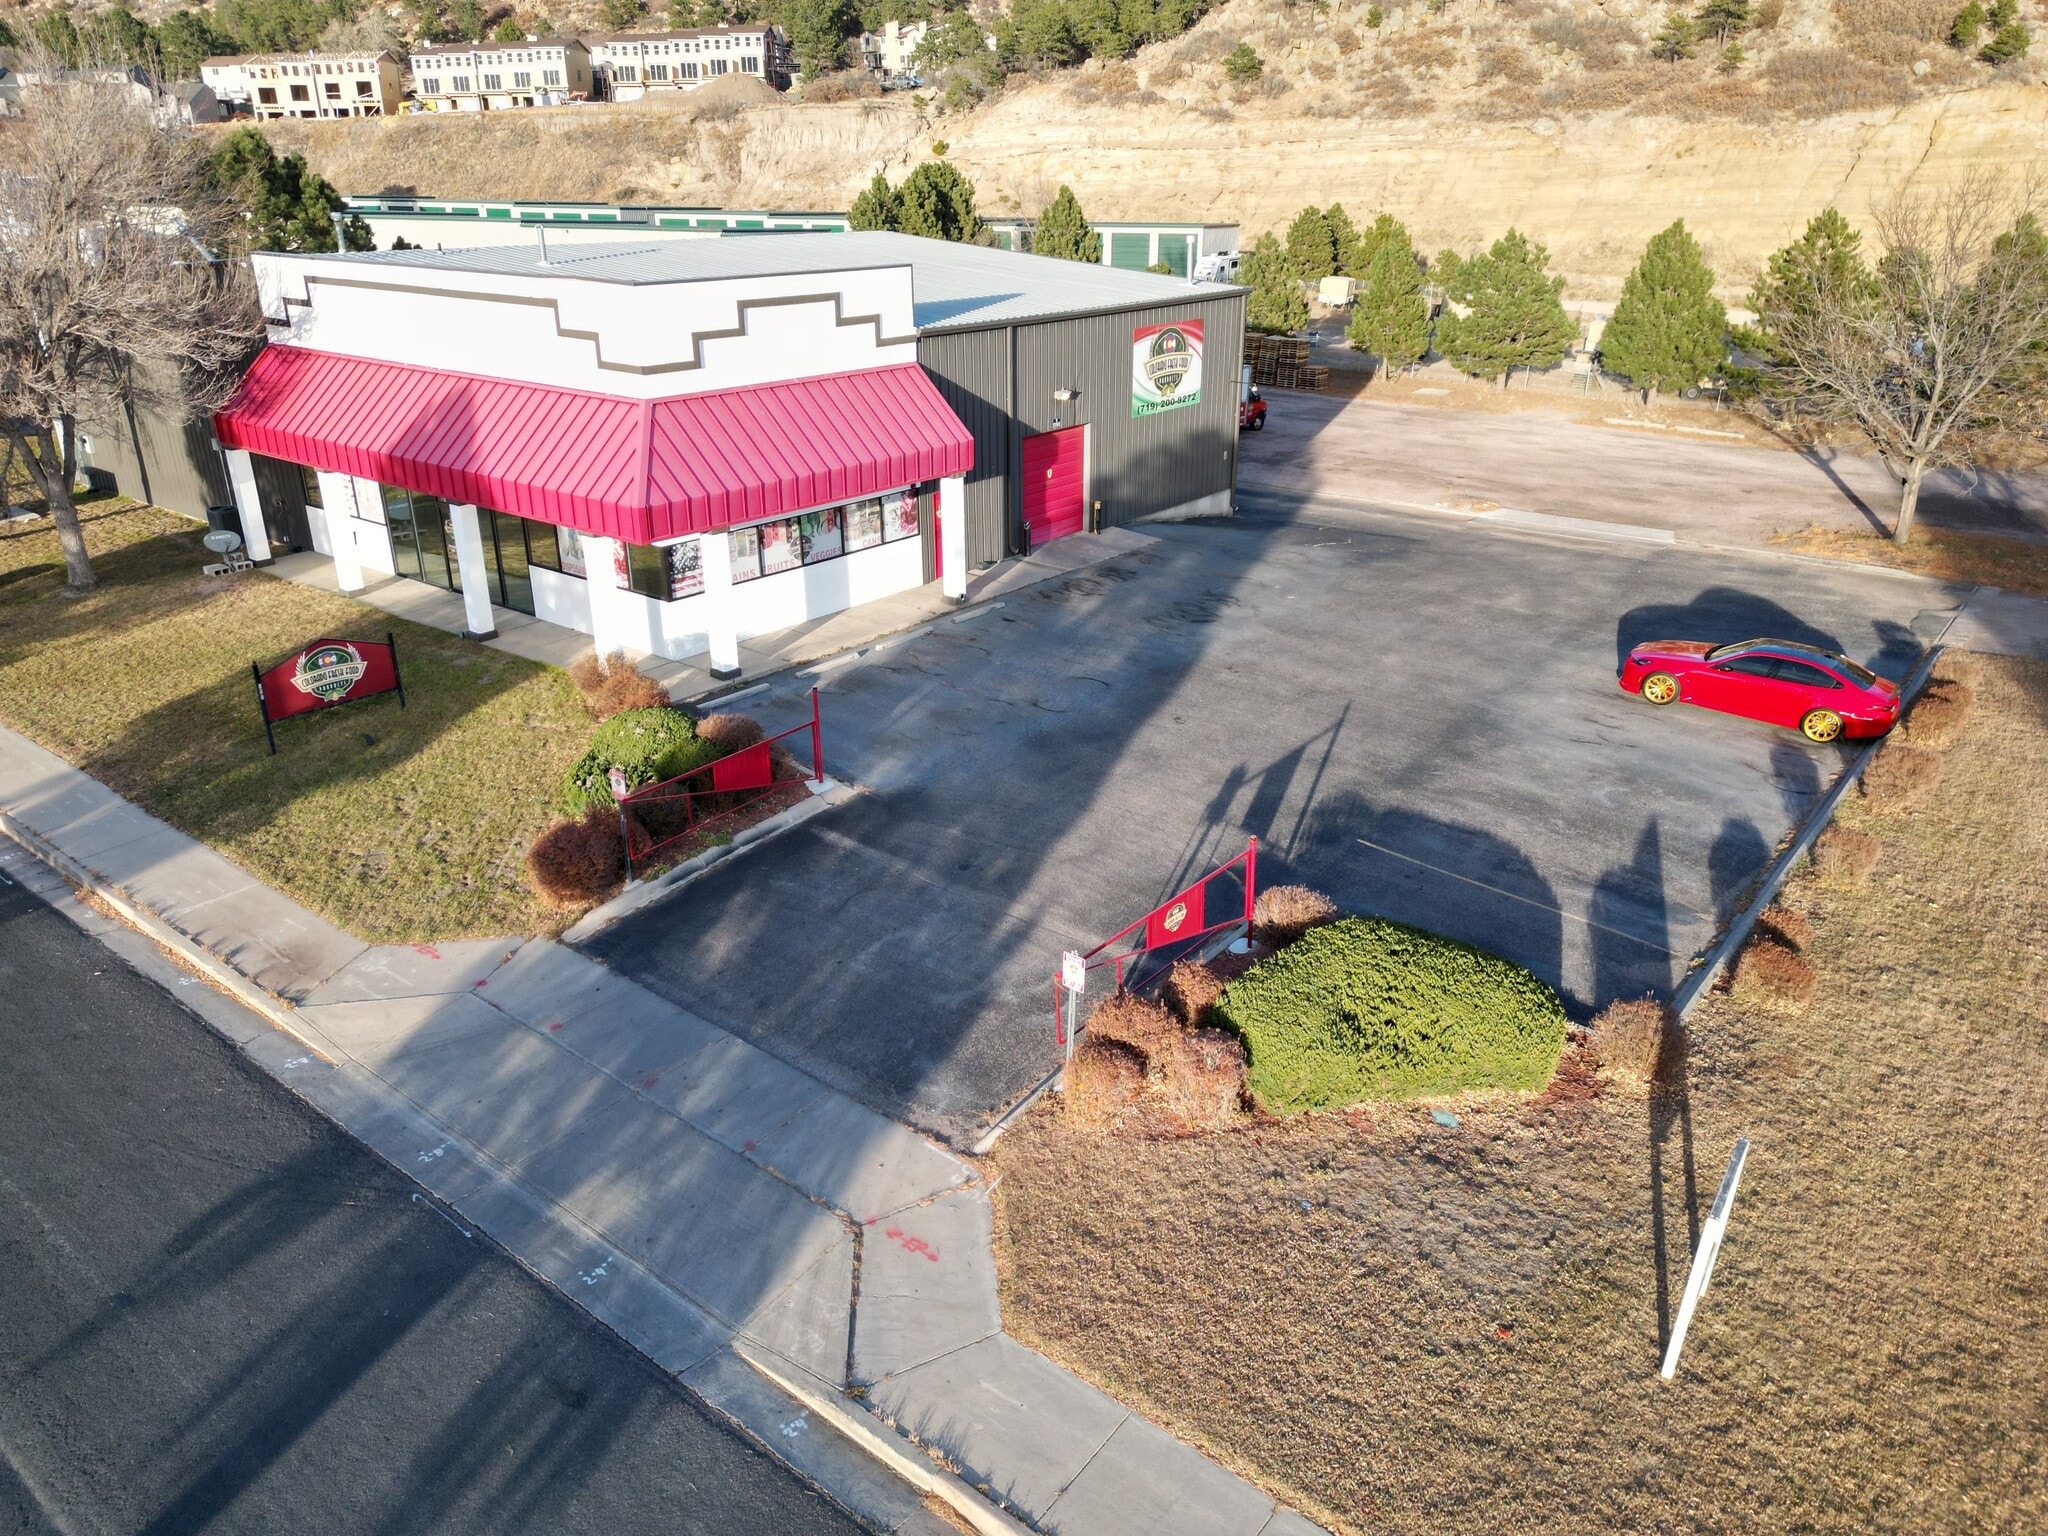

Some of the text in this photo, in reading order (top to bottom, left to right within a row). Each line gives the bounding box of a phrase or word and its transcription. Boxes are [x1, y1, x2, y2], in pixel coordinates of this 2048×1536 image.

[1137, 402, 1158, 415] (719)
[810, 546, 842, 561] VEGGIES
[302, 666, 360, 687] COLORADO FRESH FOOD
